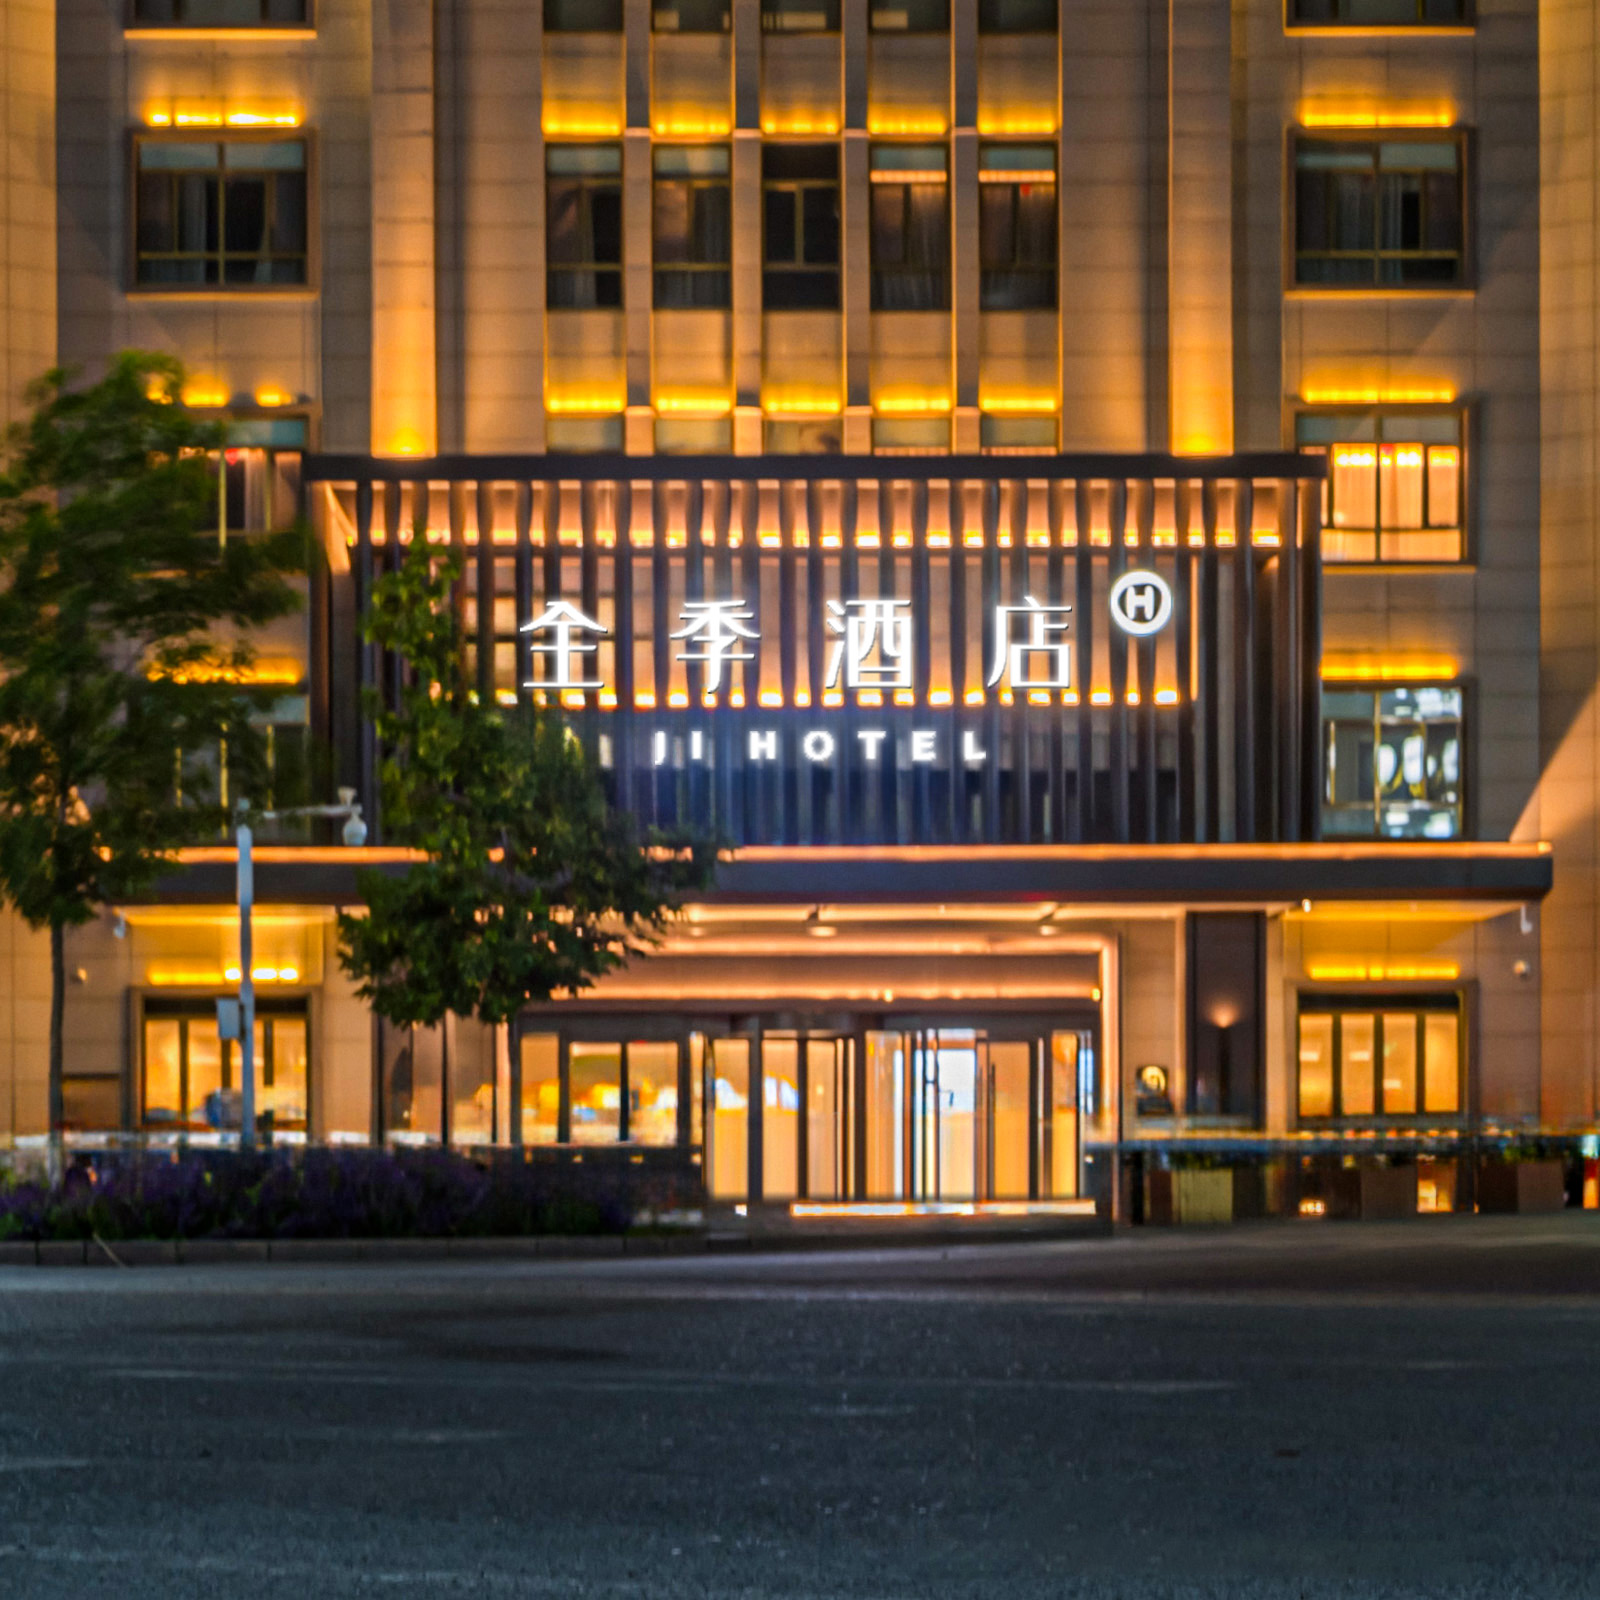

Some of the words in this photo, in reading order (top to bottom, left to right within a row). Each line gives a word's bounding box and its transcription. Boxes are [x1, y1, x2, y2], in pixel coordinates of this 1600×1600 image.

[519, 595, 1073, 693] 全季酒店
[653, 730, 703, 766] JI
[749, 730, 987, 762] HOTEL
